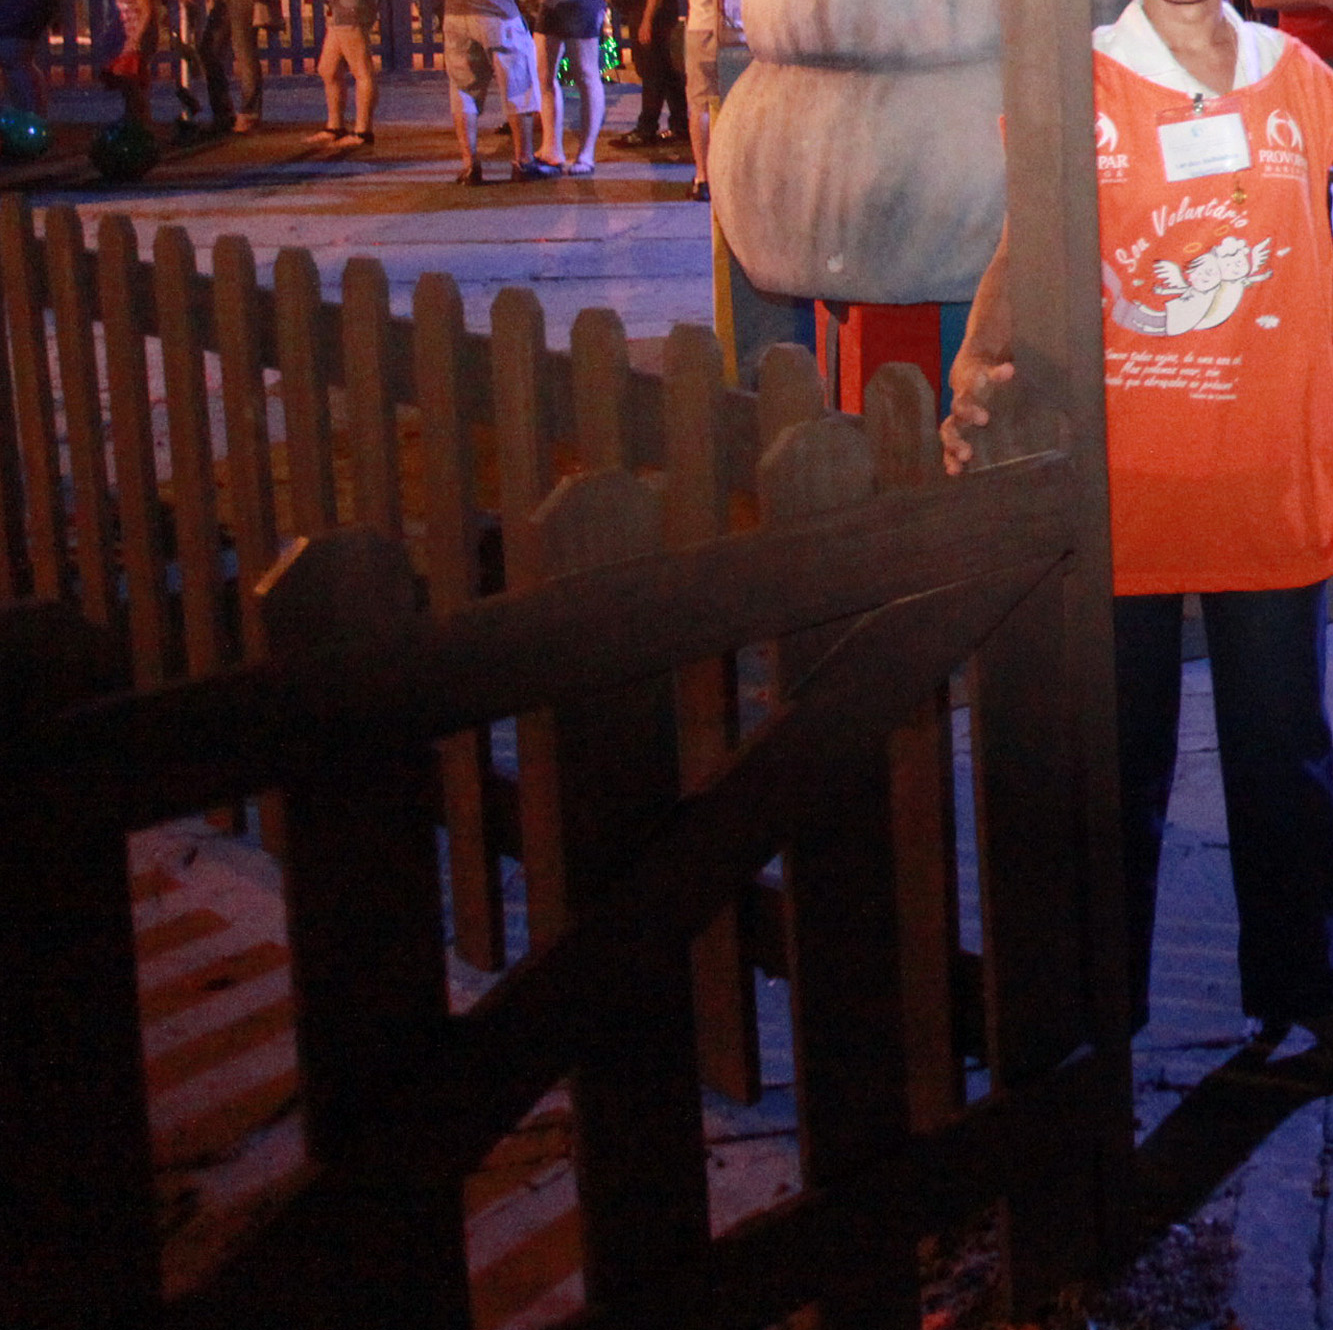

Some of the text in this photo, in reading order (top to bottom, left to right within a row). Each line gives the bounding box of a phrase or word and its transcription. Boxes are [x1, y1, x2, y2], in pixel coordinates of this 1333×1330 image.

[1098, 154, 1130, 169] PAR
[1115, 196, 1249, 273] Sou Voluntário
